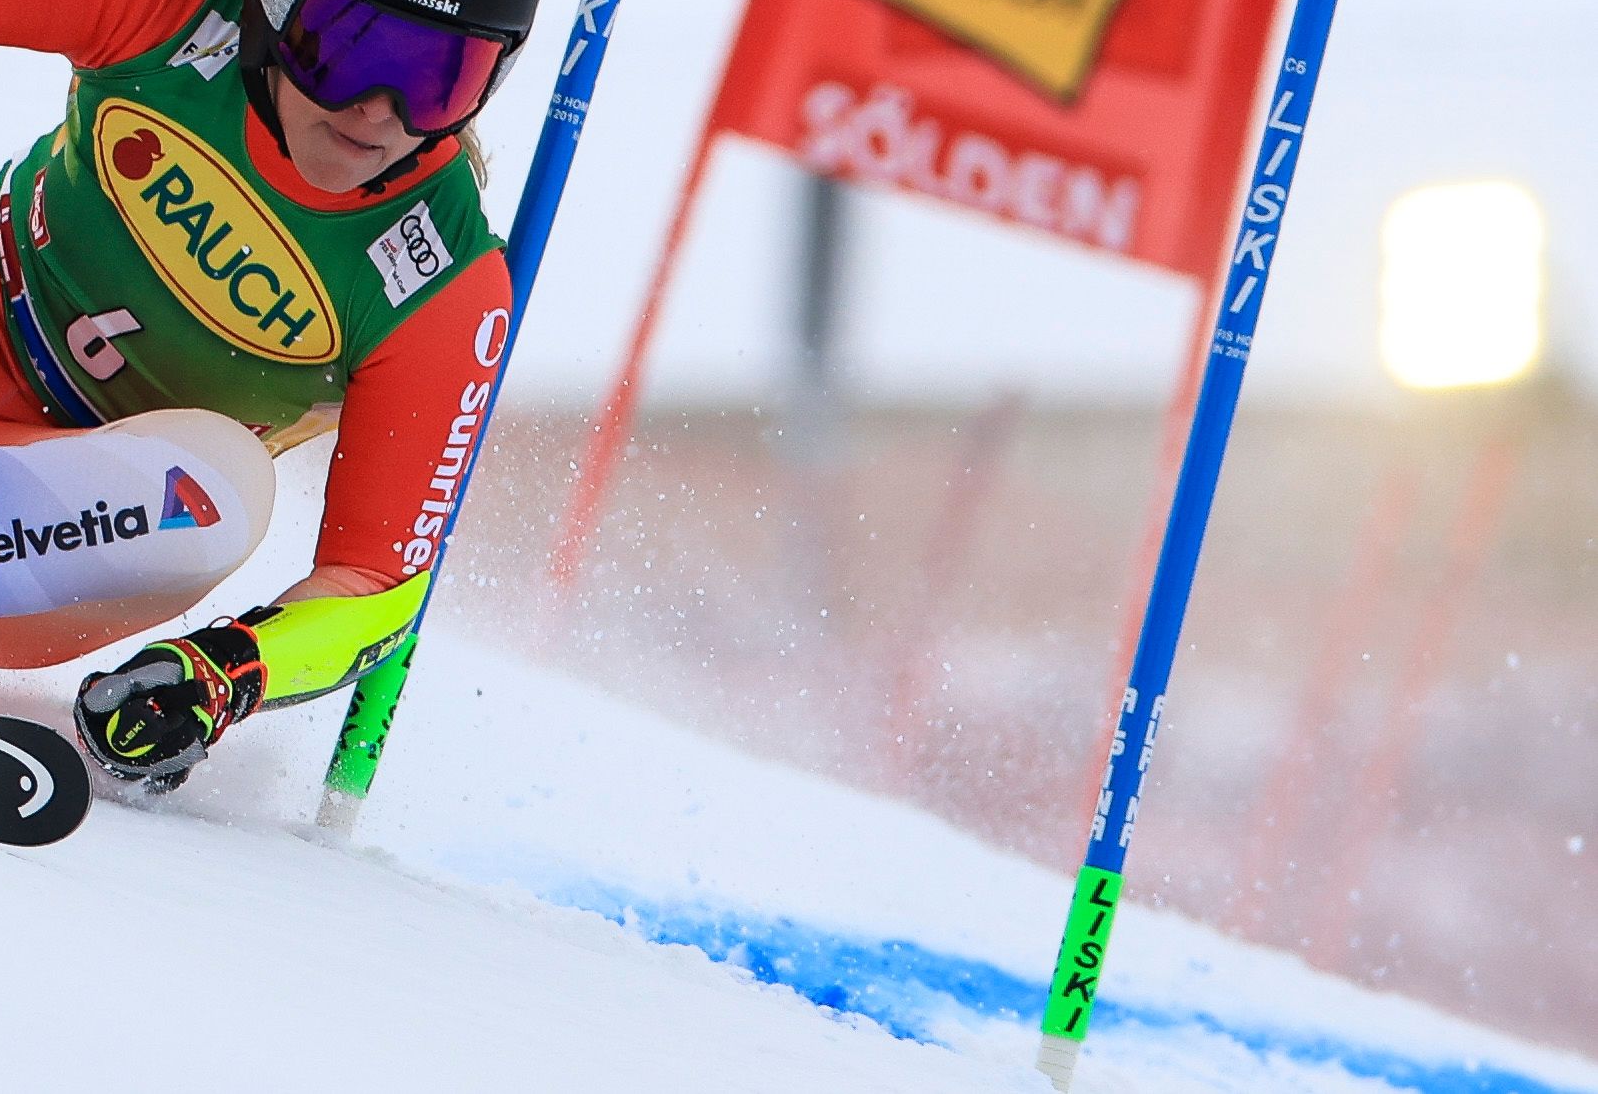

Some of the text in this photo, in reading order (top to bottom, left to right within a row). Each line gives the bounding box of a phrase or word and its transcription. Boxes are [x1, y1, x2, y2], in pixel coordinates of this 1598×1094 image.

[803, 80, 1143, 248] SÖLDEN
[1228, 90, 1302, 314] LISKI
[139, 163, 316, 348] RAUCH
[66, 308, 143, 381] 6
[118, 720, 146, 747] LEKI
[1062, 877, 1113, 1033] LISKI
